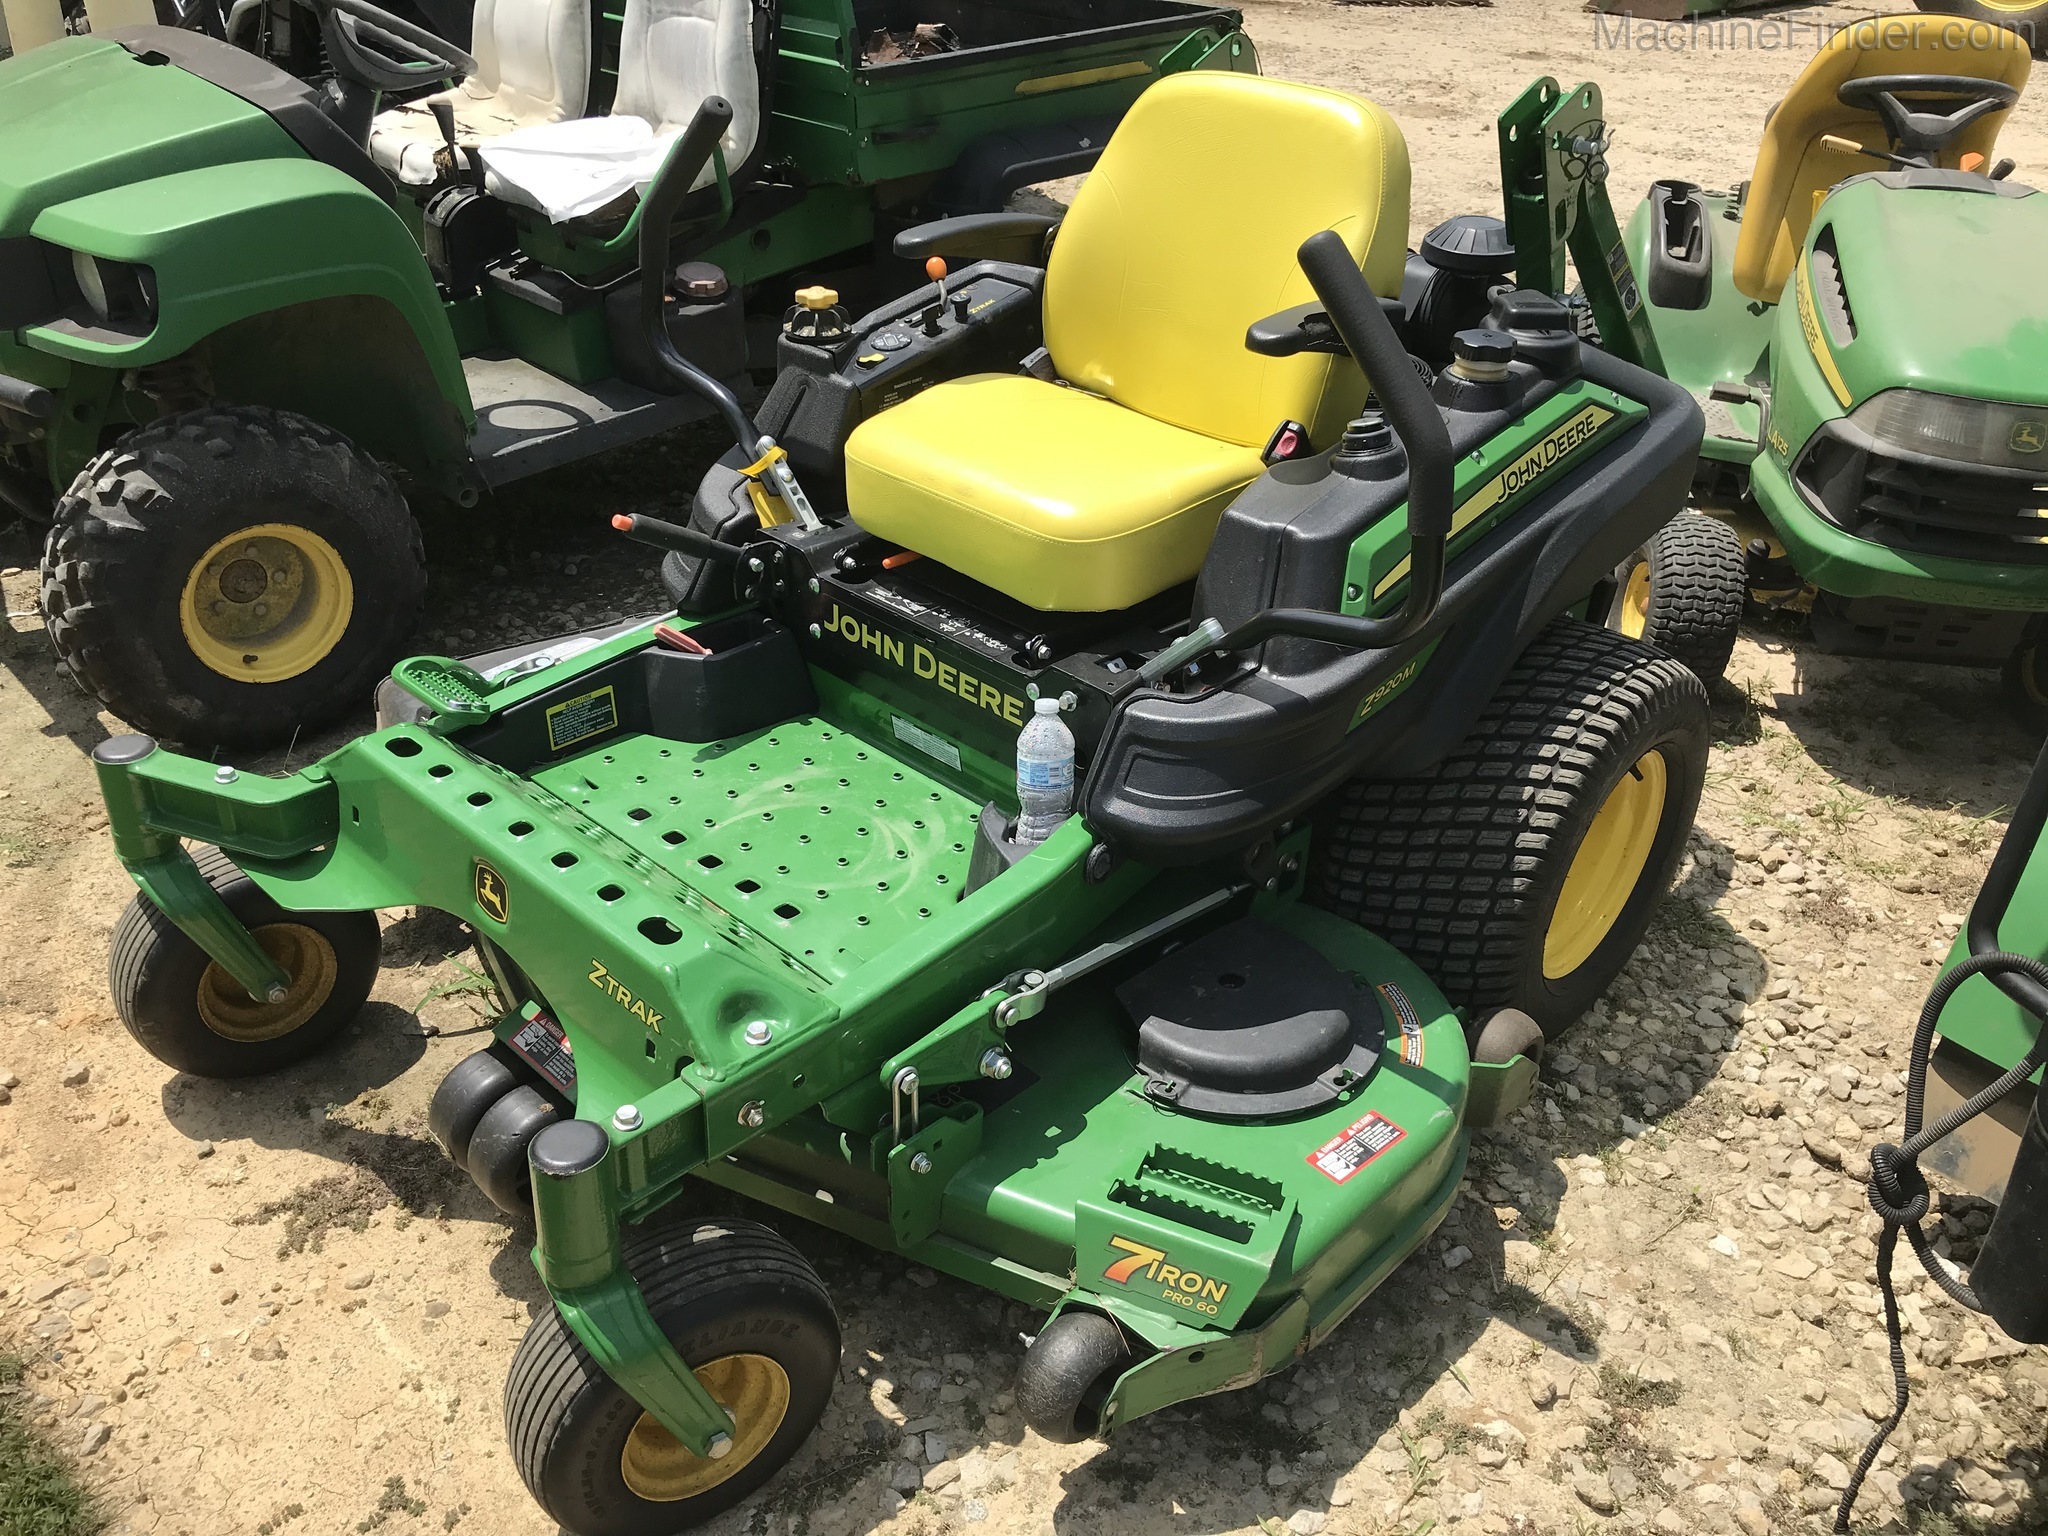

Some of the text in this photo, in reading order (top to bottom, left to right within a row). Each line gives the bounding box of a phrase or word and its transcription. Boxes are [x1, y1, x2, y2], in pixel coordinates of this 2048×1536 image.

[1767, 421, 1789, 456] LA125
[1498, 412, 1597, 500] JOHN DEERE
[823, 603, 1025, 727] JOHN DEERE
[569, 693, 592, 706] CAUTION
[1360, 660, 1417, 717] Z920M
[588, 957, 664, 1034] ZTRAK
[545, 1021, 564, 1039] DANGER
[1351, 1113, 1375, 1131] PELIGRO
[1320, 1136, 1344, 1154] DANGER
[1146, 1259, 1229, 1303] IRON
[1162, 1288, 1218, 1315] PRO 60
[681, 1319, 800, 1350] ELIANCE
